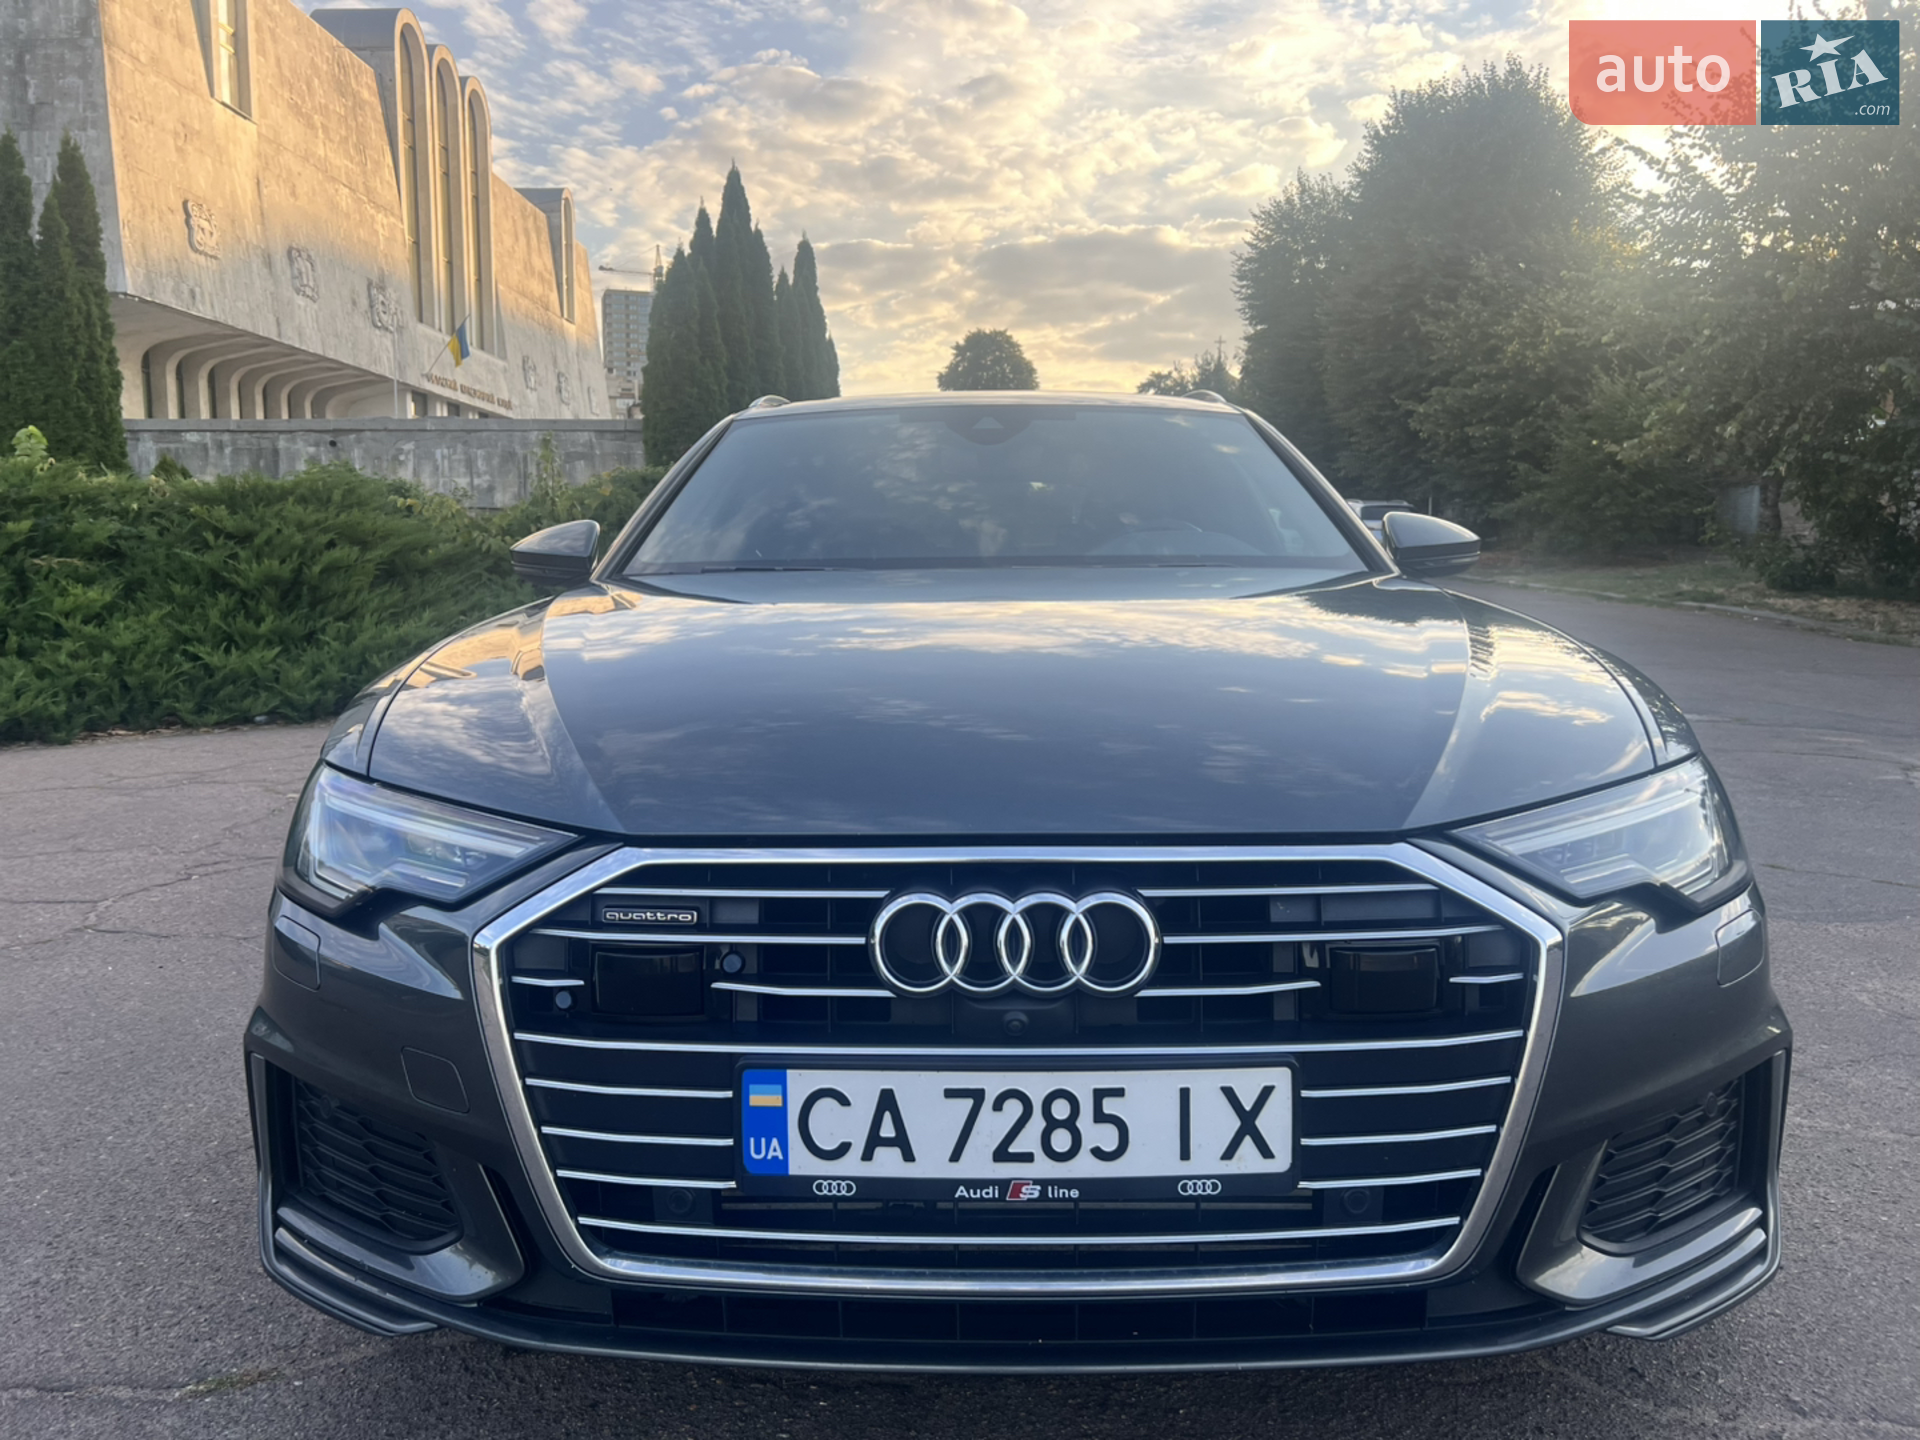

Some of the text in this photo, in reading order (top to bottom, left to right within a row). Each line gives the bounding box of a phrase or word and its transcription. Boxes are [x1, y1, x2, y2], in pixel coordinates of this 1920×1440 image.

[606, 911, 692, 921] quattro
[798, 1084, 1277, 1164] CA 7285 IX
[750, 1137, 783, 1160] UA
[955, 1185, 999, 1198] Audi
[1048, 1186, 1080, 1198] line
